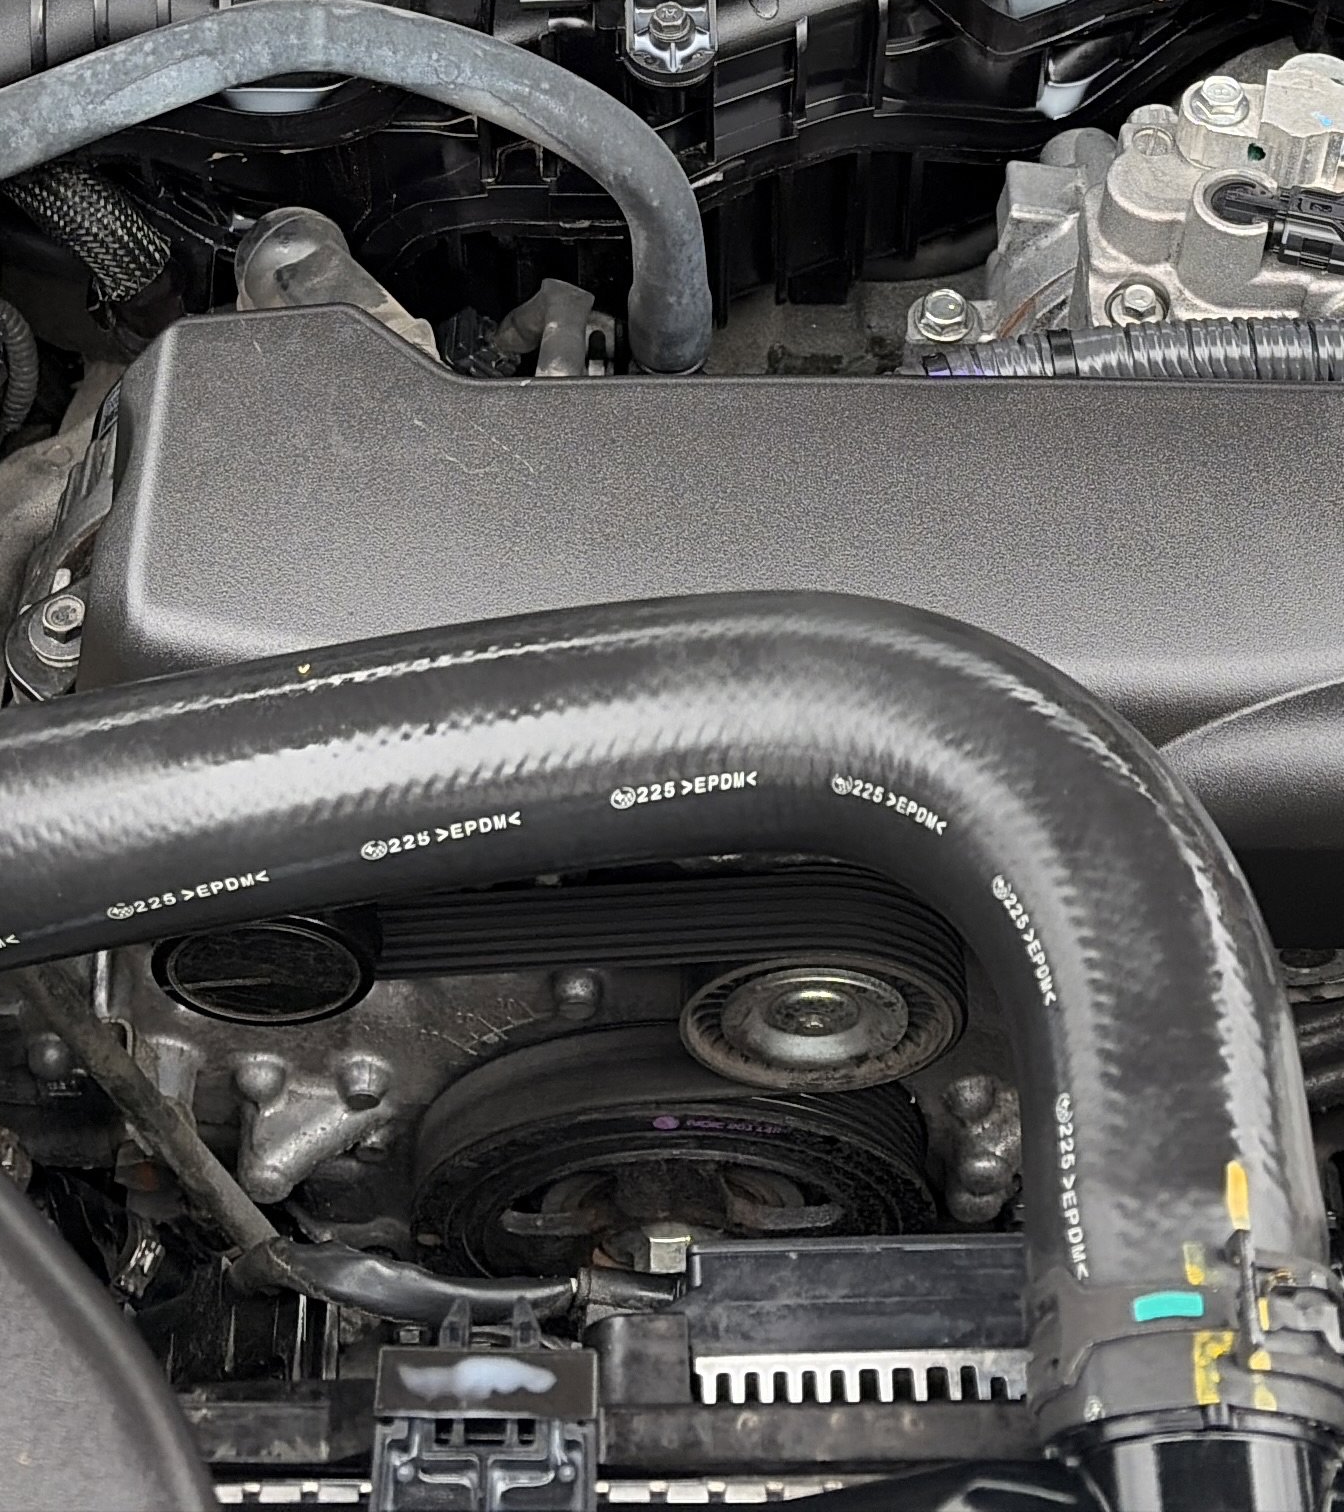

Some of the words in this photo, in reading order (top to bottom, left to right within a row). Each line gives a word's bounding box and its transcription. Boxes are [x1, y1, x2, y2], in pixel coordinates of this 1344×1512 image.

[637, 781, 675, 804] 225
[851, 779, 885, 804] 225
[133, 891, 176, 914] 225
[1003, 892, 1030, 930] 225
[1057, 1122, 1077, 1171] 225
